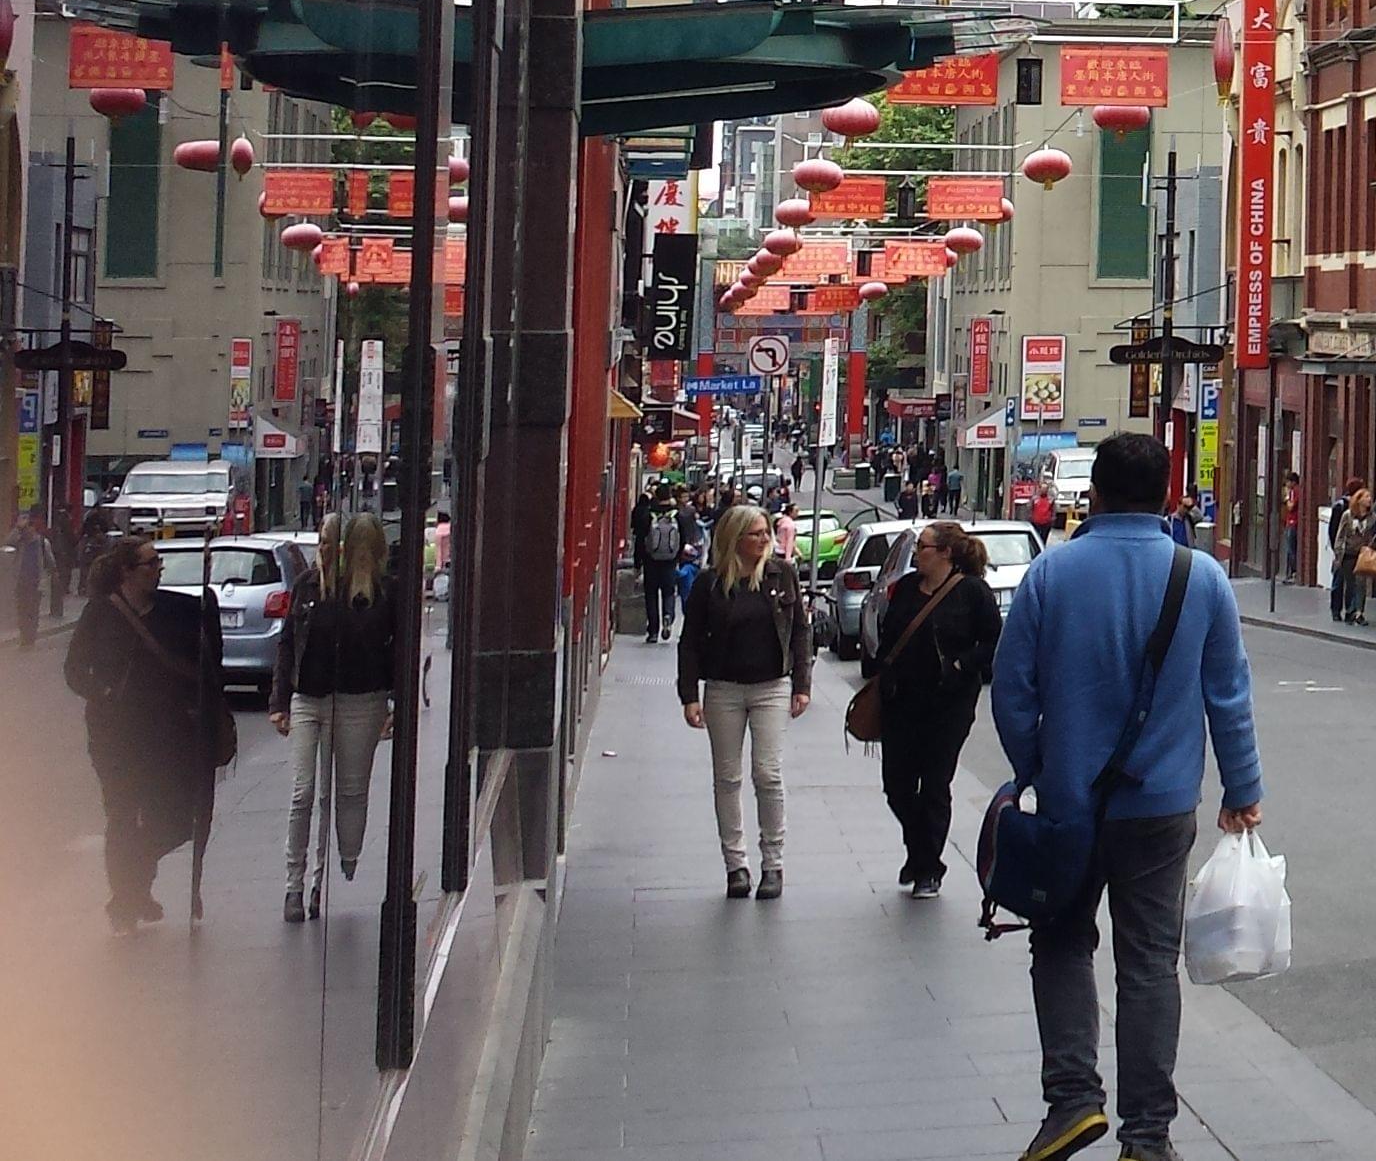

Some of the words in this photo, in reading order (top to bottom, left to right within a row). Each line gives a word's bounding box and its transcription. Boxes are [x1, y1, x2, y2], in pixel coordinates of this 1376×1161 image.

[1247, 6, 1272, 146] 大富貴
[1250, 177, 1266, 238] CHINA
[1249, 241, 1263, 263] OF
[653, 271, 689, 350] shine
[1247, 269, 1262, 356] EMPRESS
[699, 379, 739, 392] Market
[742, 378, 757, 390] La
[1204, 385, 1219, 408] P
